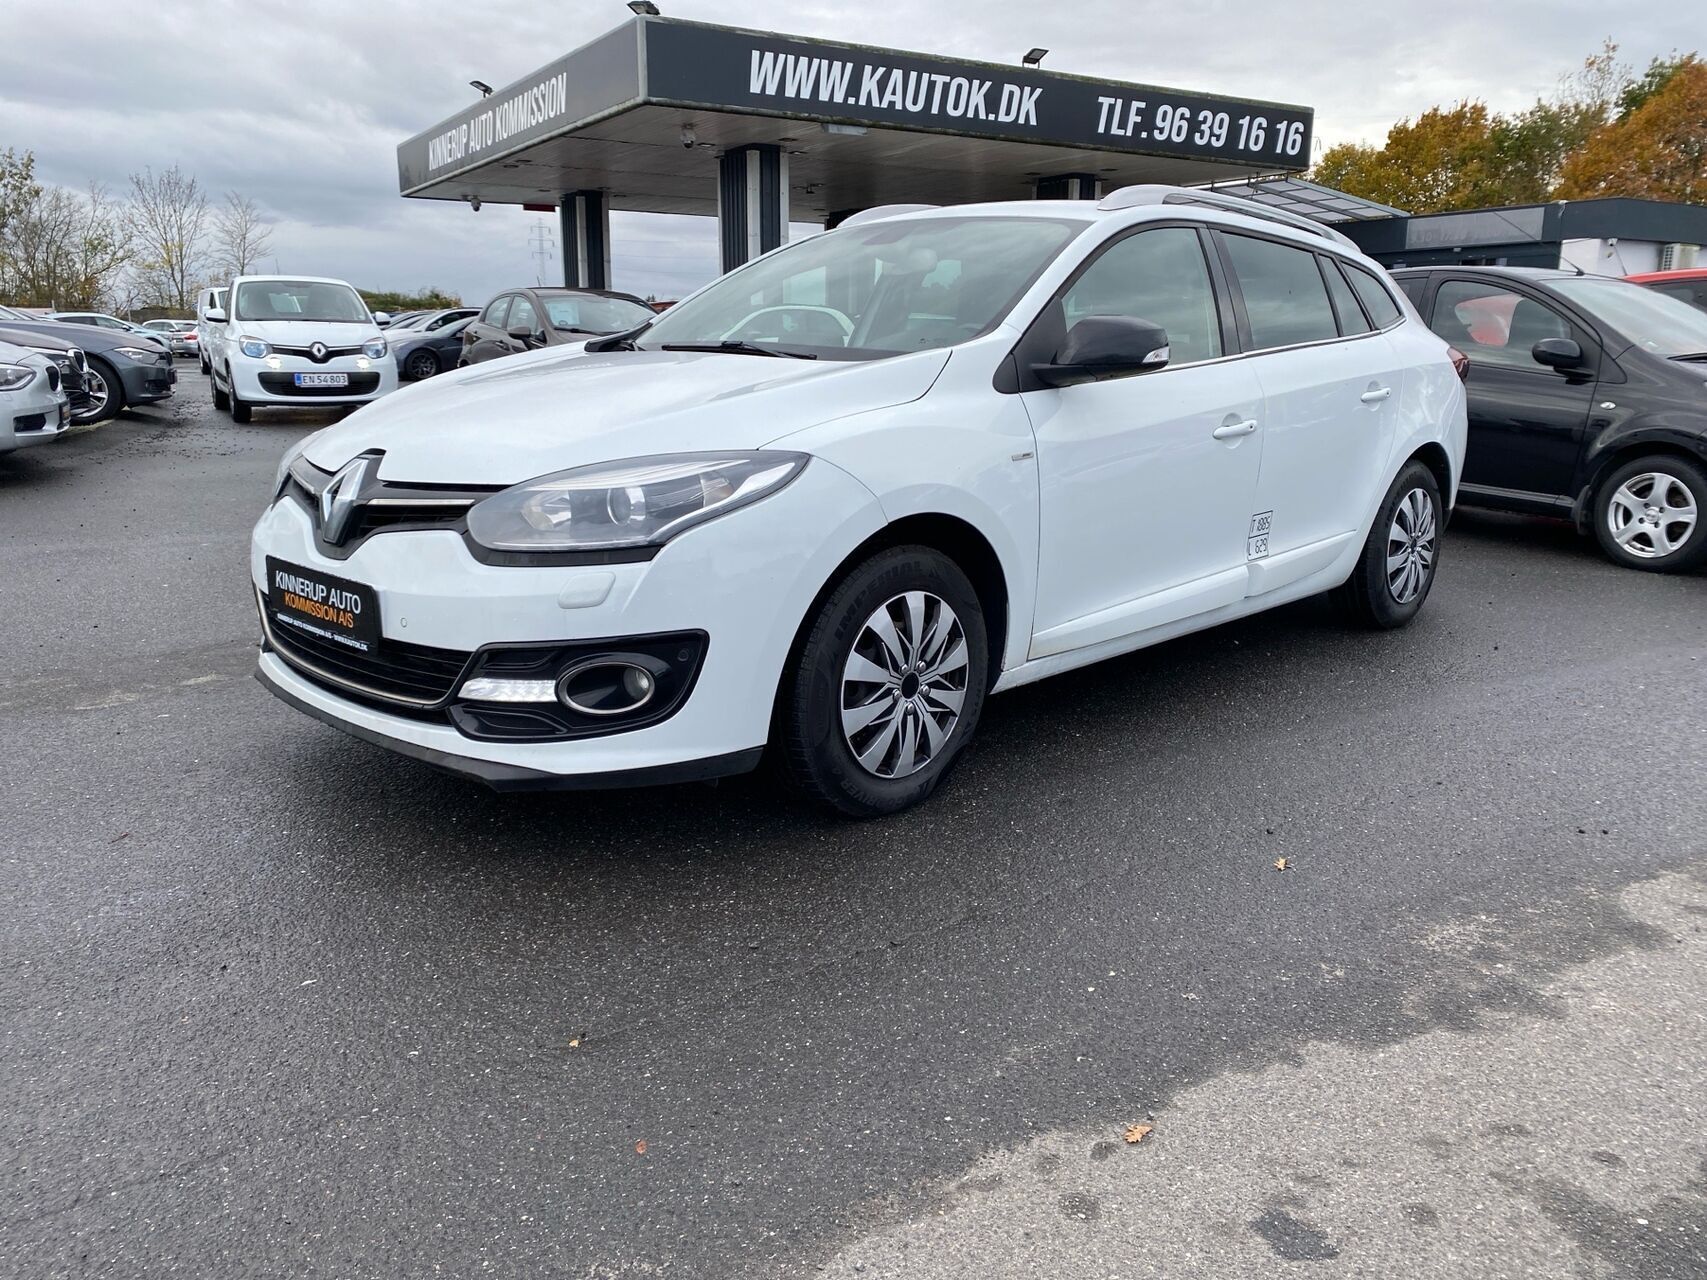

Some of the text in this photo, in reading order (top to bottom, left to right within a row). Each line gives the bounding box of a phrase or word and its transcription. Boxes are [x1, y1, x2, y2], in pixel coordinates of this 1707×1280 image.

[749, 49, 1043, 127] WWW.KAUTOK.DK
[429, 72, 567, 171] KINNERUP AUTO KOMMISSION
[1097, 95, 1304, 156] TLF. 96 39 16 16
[303, 375, 346, 384] EN 54803
[275, 570, 362, 615] KINNERUP AUTO
[285, 592, 354, 628] KOMMISSION A/S
